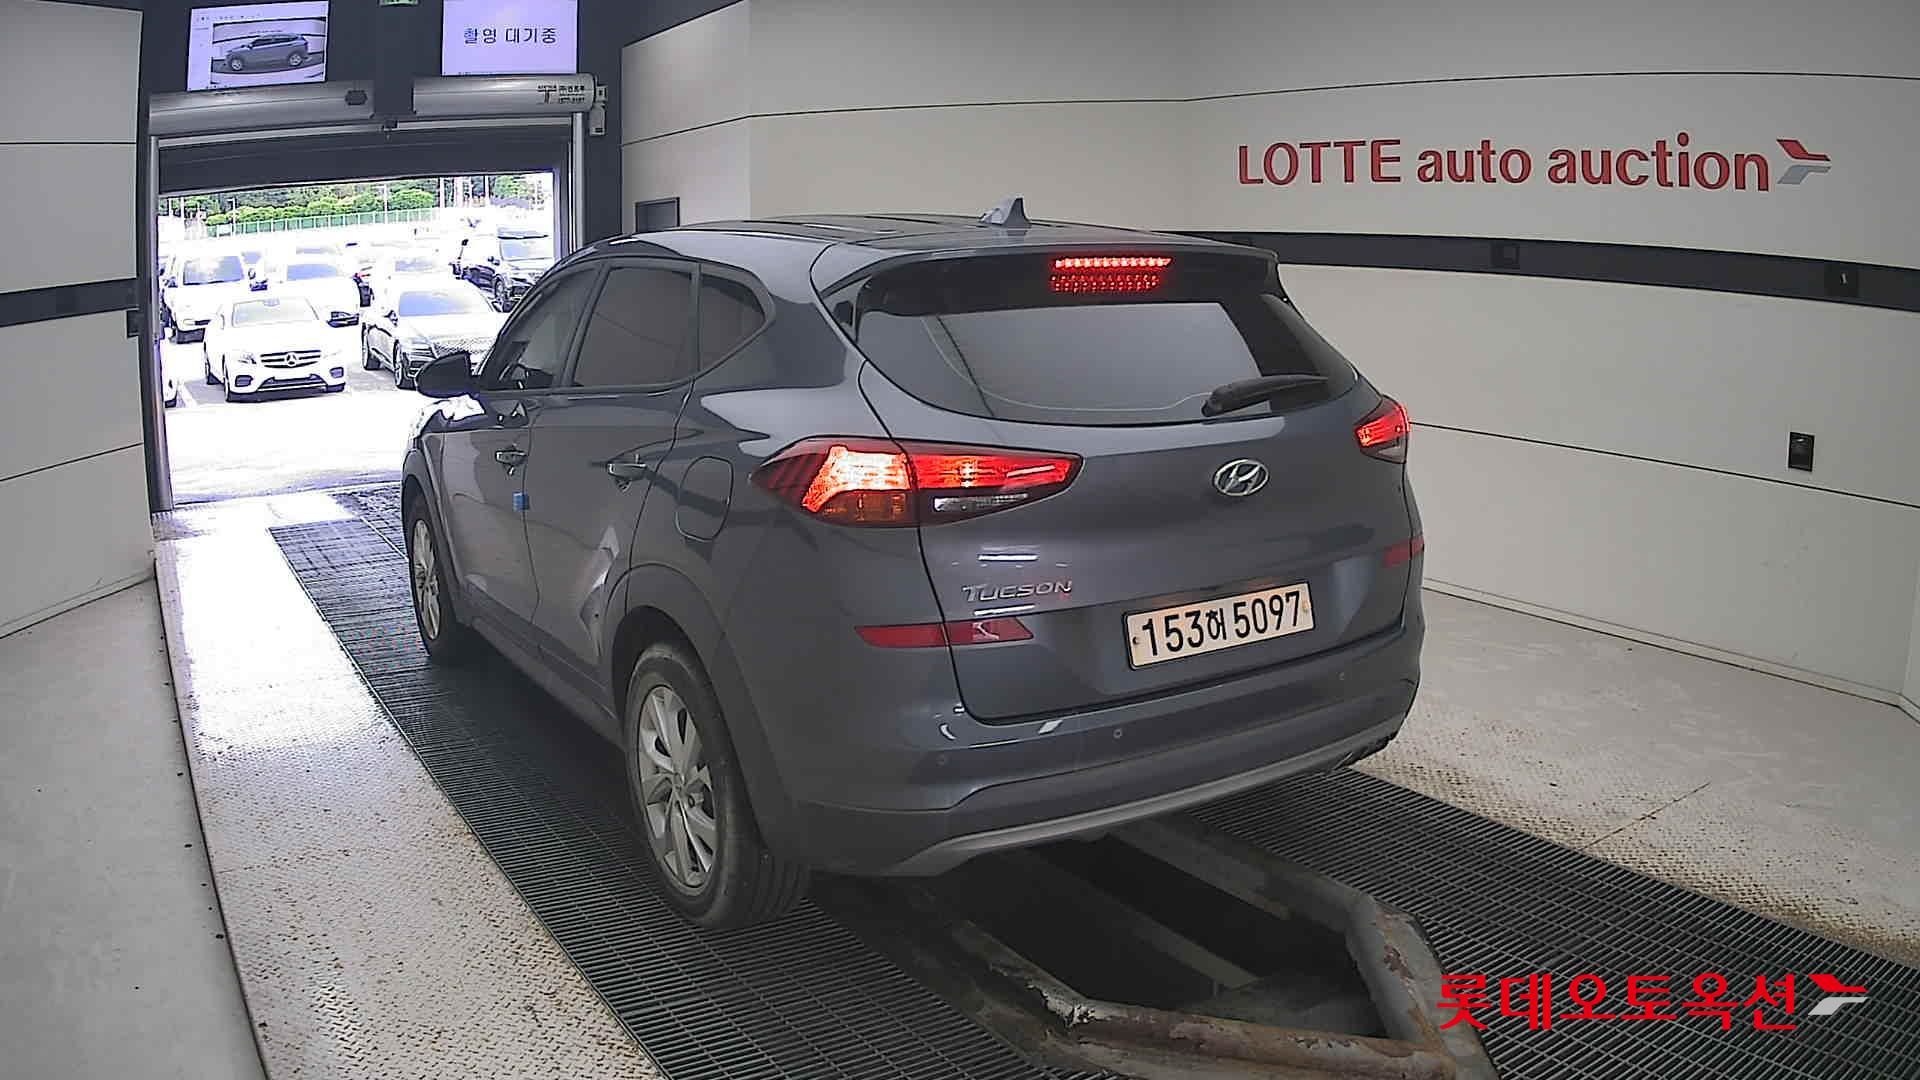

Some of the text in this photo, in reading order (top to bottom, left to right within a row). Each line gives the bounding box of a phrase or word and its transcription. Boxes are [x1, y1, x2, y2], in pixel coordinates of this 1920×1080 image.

[505, 27, 556, 44] 대기중
[1238, 132, 1770, 191] LOTTE auto auction
